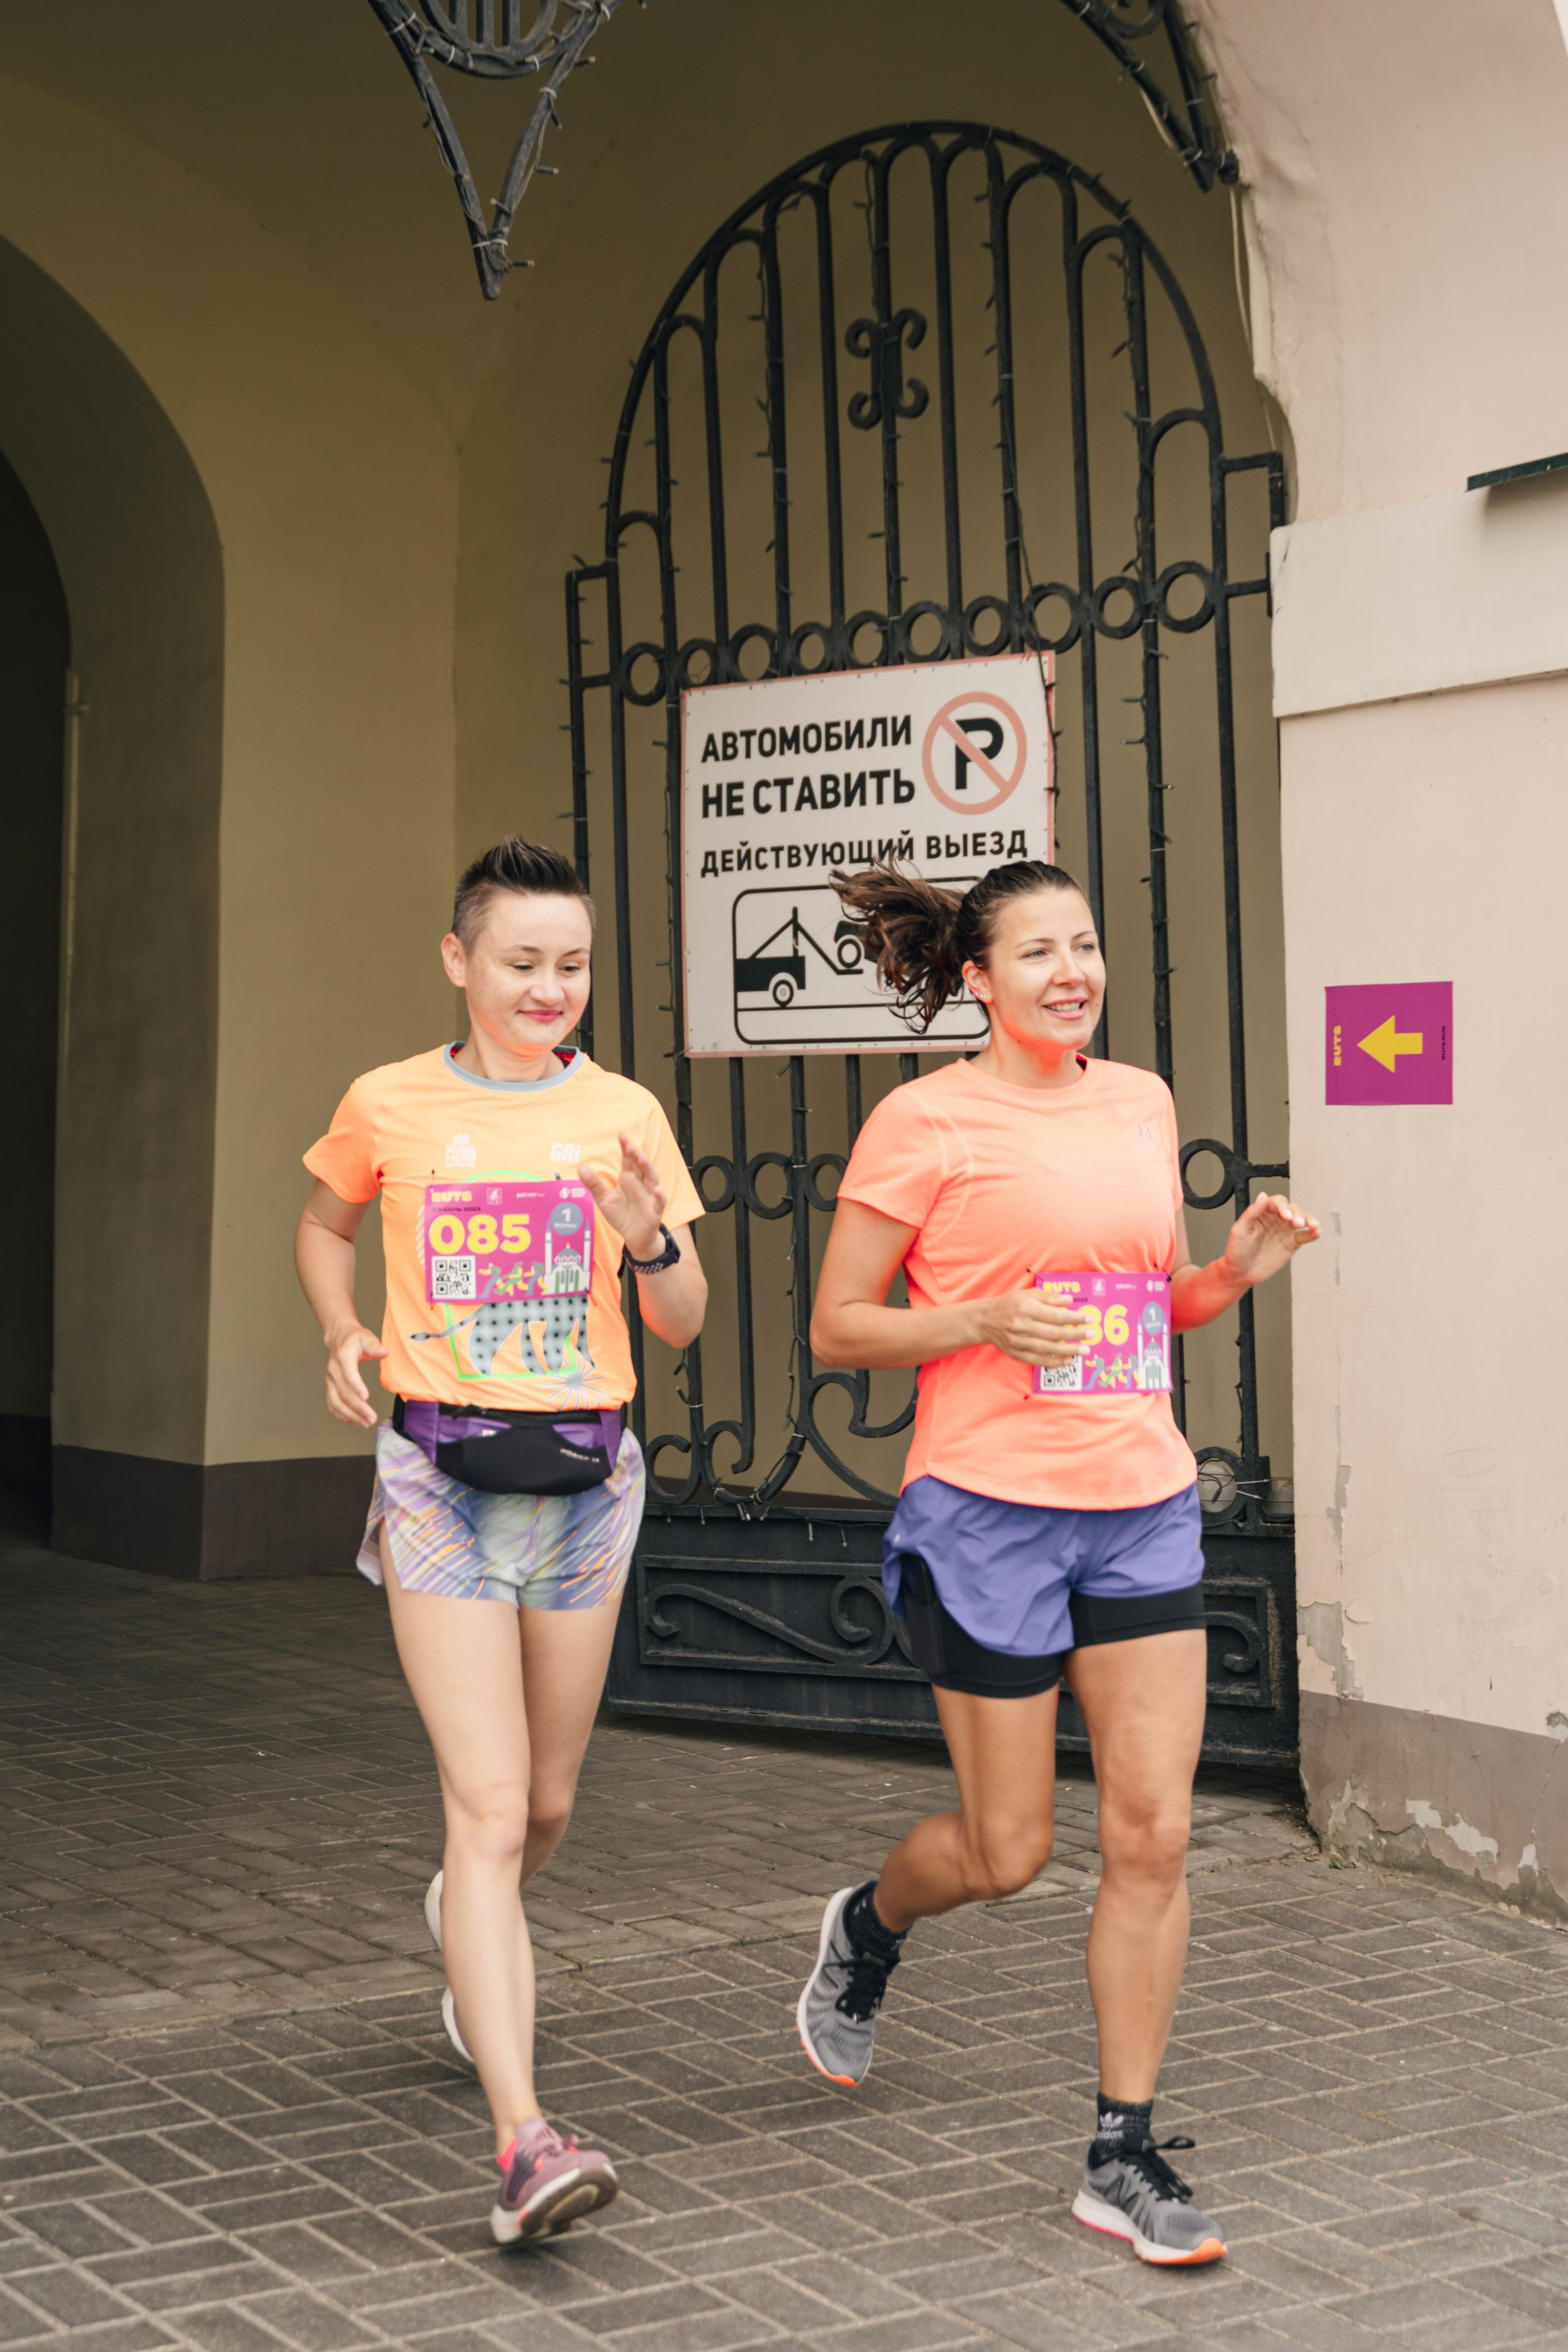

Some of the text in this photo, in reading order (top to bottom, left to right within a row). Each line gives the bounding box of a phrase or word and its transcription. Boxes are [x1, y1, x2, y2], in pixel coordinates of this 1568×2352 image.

[701, 715, 911, 763] АВТОМОБИЛИ
[702, 769, 915, 818] НЕ СТАВИТЬ
[701, 829, 1028, 877] ДЕЙСТВУЮЩИЙ ВЫЕЗД
[432, 1191, 472, 1202] RUTS
[562, 1208, 571, 1221] 1
[429, 1213, 531, 1254] 085
[1043, 1281, 1081, 1293] RUTS
[1149, 1307, 1156, 1322] 1
